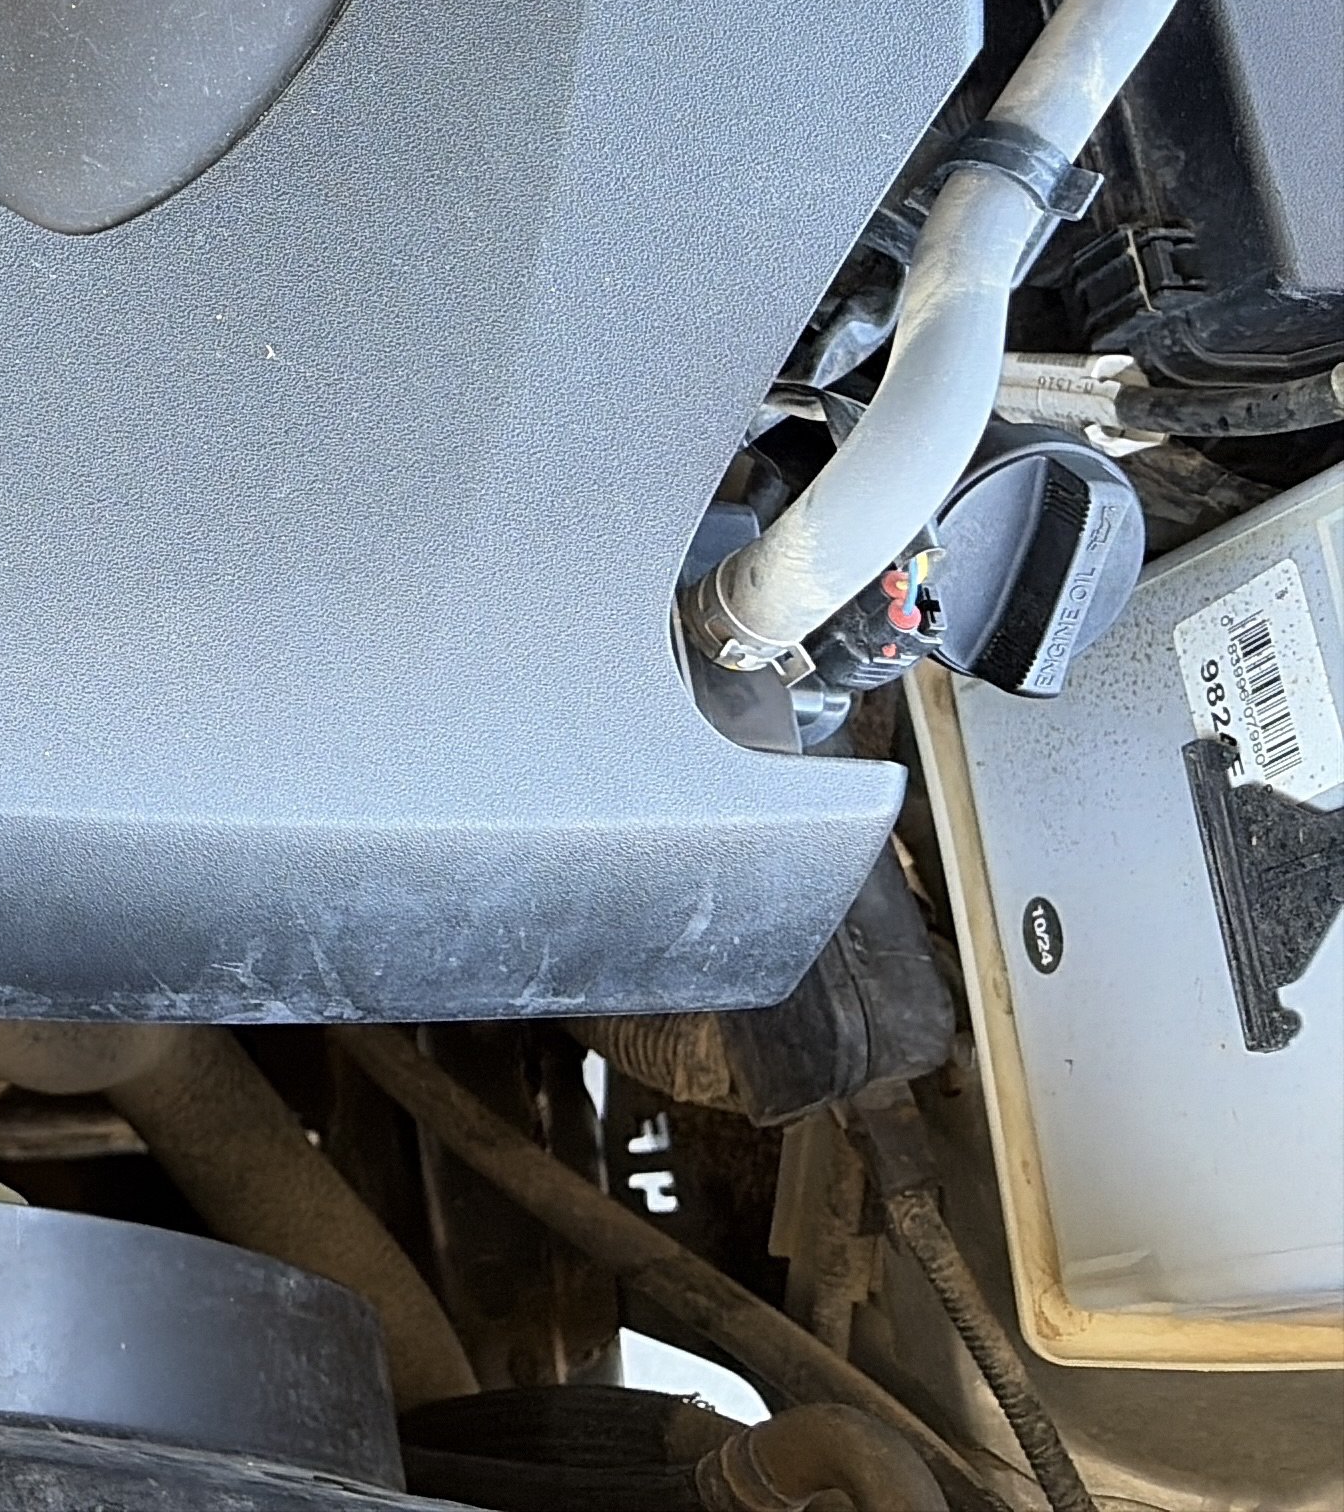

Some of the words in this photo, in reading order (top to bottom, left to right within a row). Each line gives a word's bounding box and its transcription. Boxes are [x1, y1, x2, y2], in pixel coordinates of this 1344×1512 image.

[1034, 607, 1081, 687] ENGINE
[1069, 567, 1096, 601] OIL
[1032, 904, 1053, 966] 10/24
